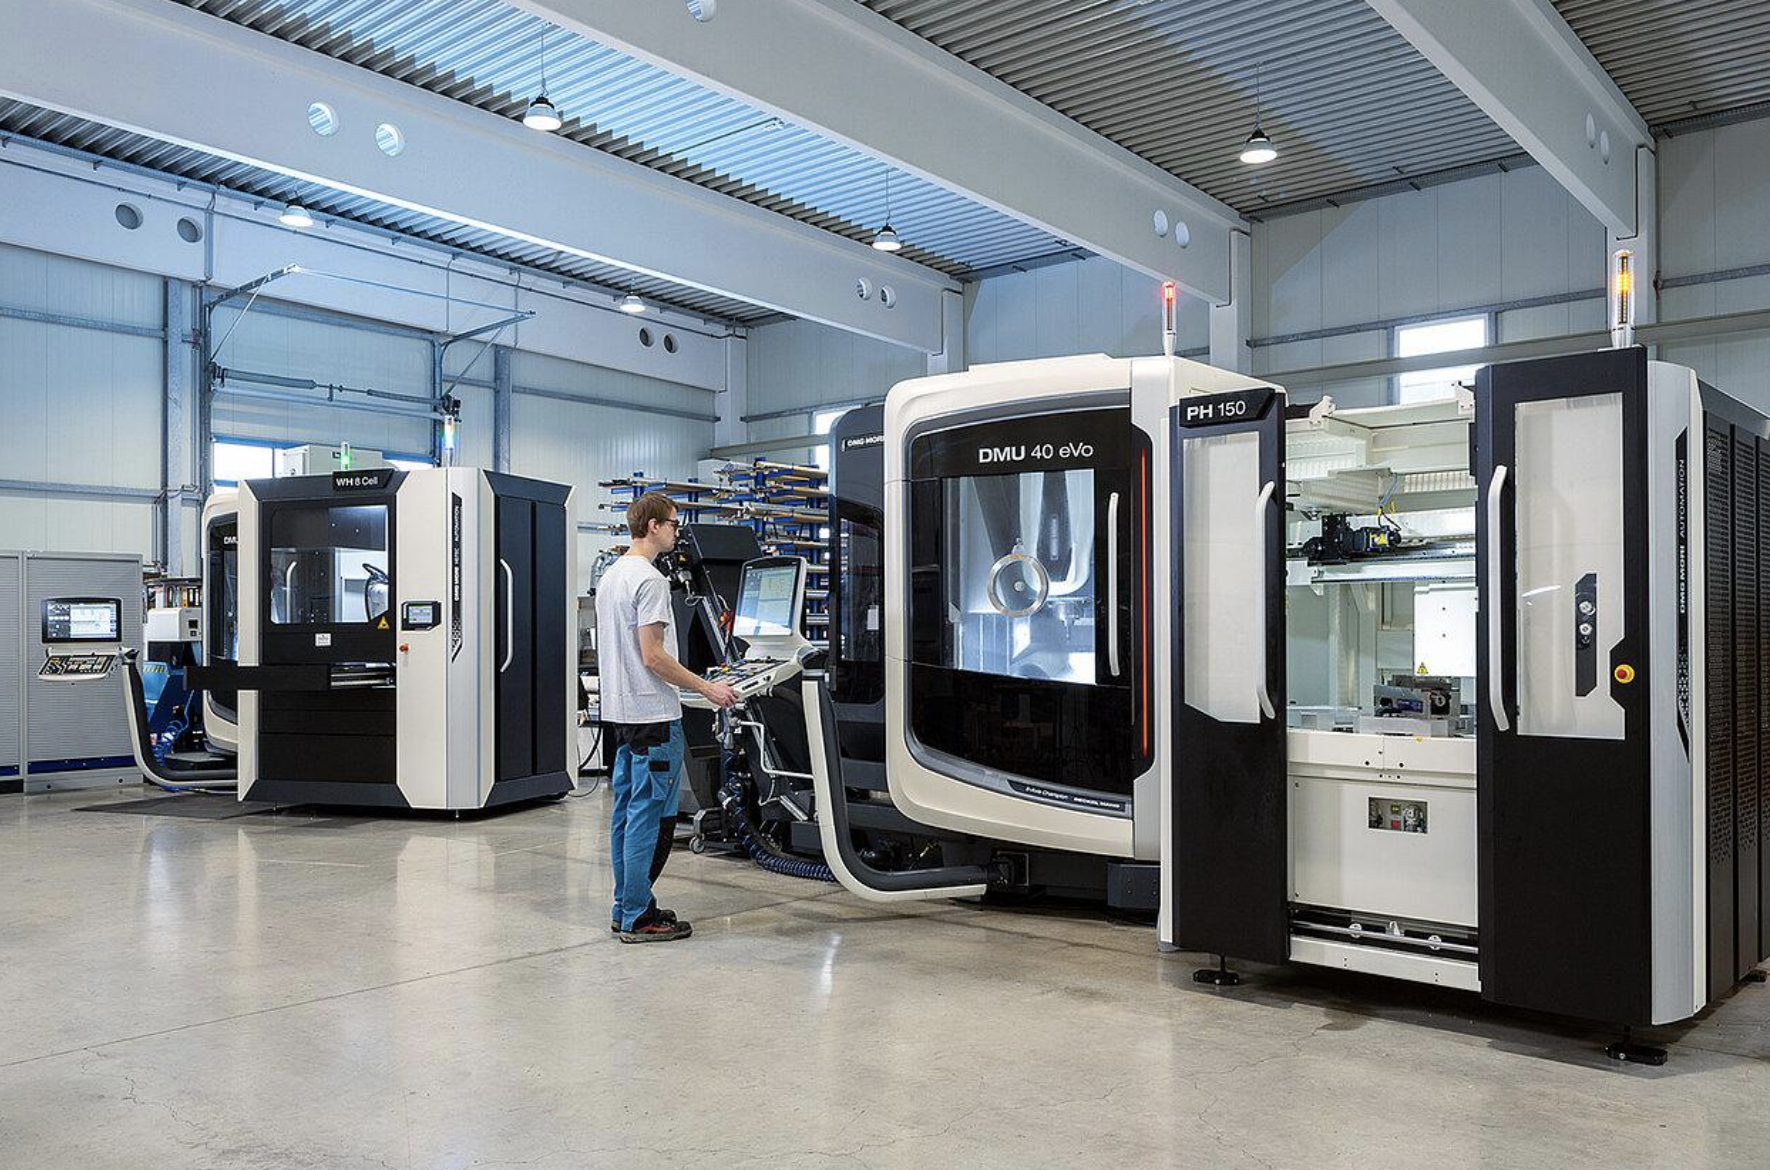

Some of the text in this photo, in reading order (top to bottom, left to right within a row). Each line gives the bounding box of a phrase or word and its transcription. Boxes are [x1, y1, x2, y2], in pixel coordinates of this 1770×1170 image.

[1187, 400, 1246, 420] PH 150
[866, 435, 884, 444] MOR
[979, 442, 1094, 463] DMU 40 eVo
[336, 477, 353, 486] WH
[362, 476, 379, 486] Cell
